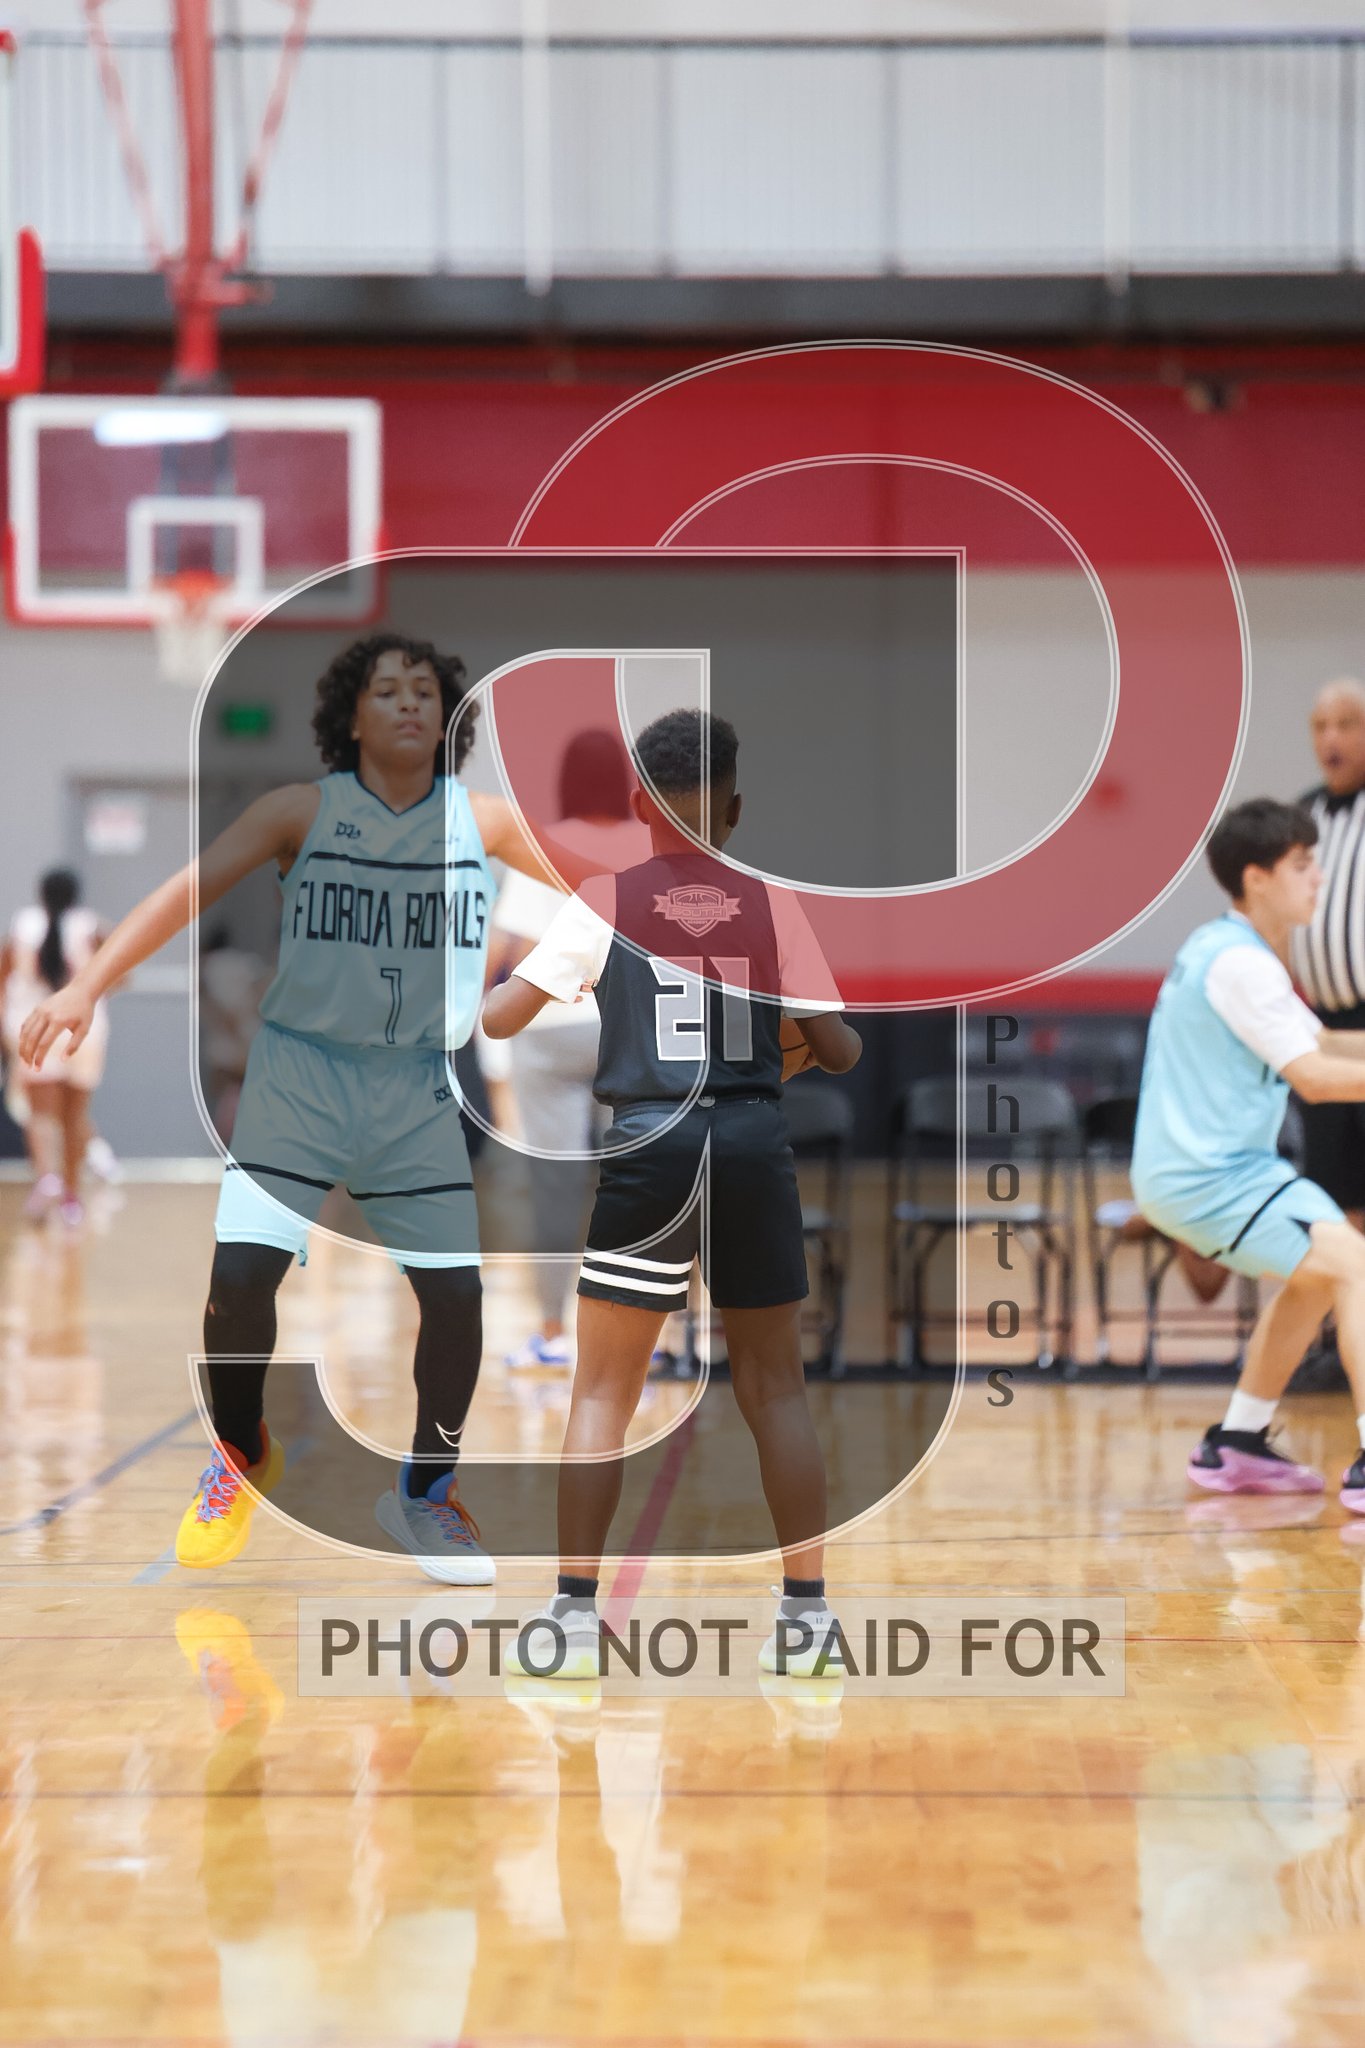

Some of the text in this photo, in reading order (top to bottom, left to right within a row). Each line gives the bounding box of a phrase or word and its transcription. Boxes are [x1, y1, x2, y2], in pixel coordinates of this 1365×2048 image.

[671, 906, 722, 918] SOUTH
[380, 967, 402, 1045] 7
[648, 956, 753, 1061] 21
